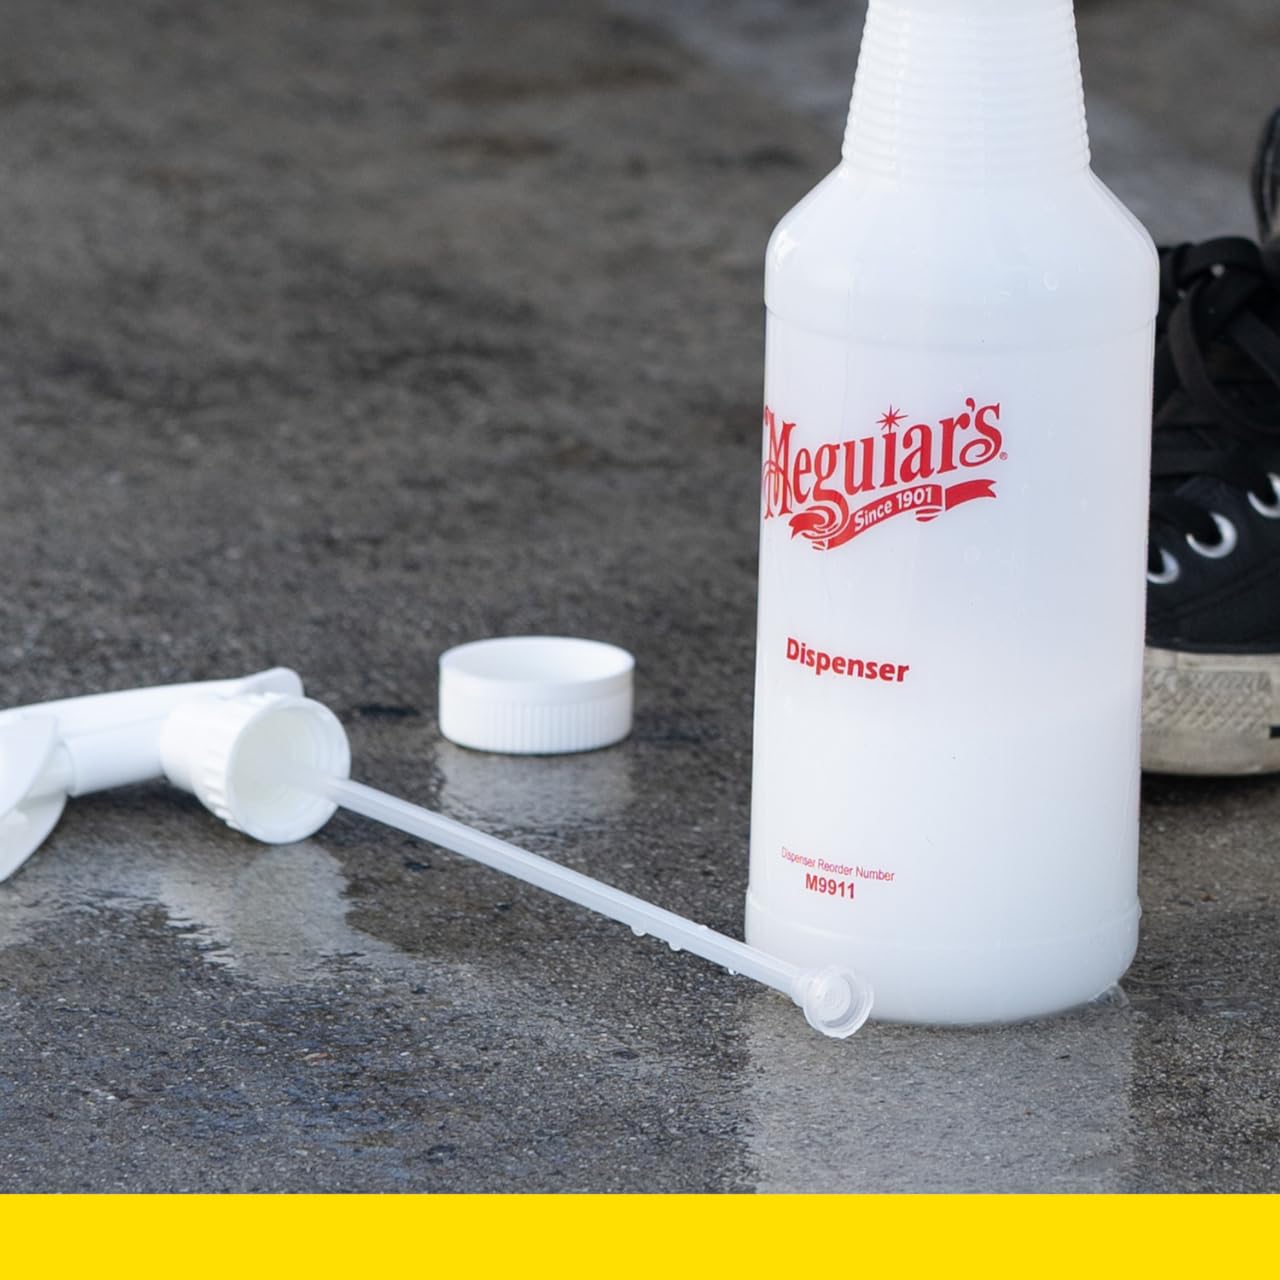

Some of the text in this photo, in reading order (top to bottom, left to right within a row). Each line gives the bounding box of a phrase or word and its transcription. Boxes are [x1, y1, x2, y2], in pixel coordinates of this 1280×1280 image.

[764, 397, 1001, 543] Meguiar's
[854, 486, 933, 532] Since 1901
[786, 638, 910, 682] Dispenser
[781, 846, 895, 882] Dispenser Reorder Number
[805, 873, 855, 899] M9911
